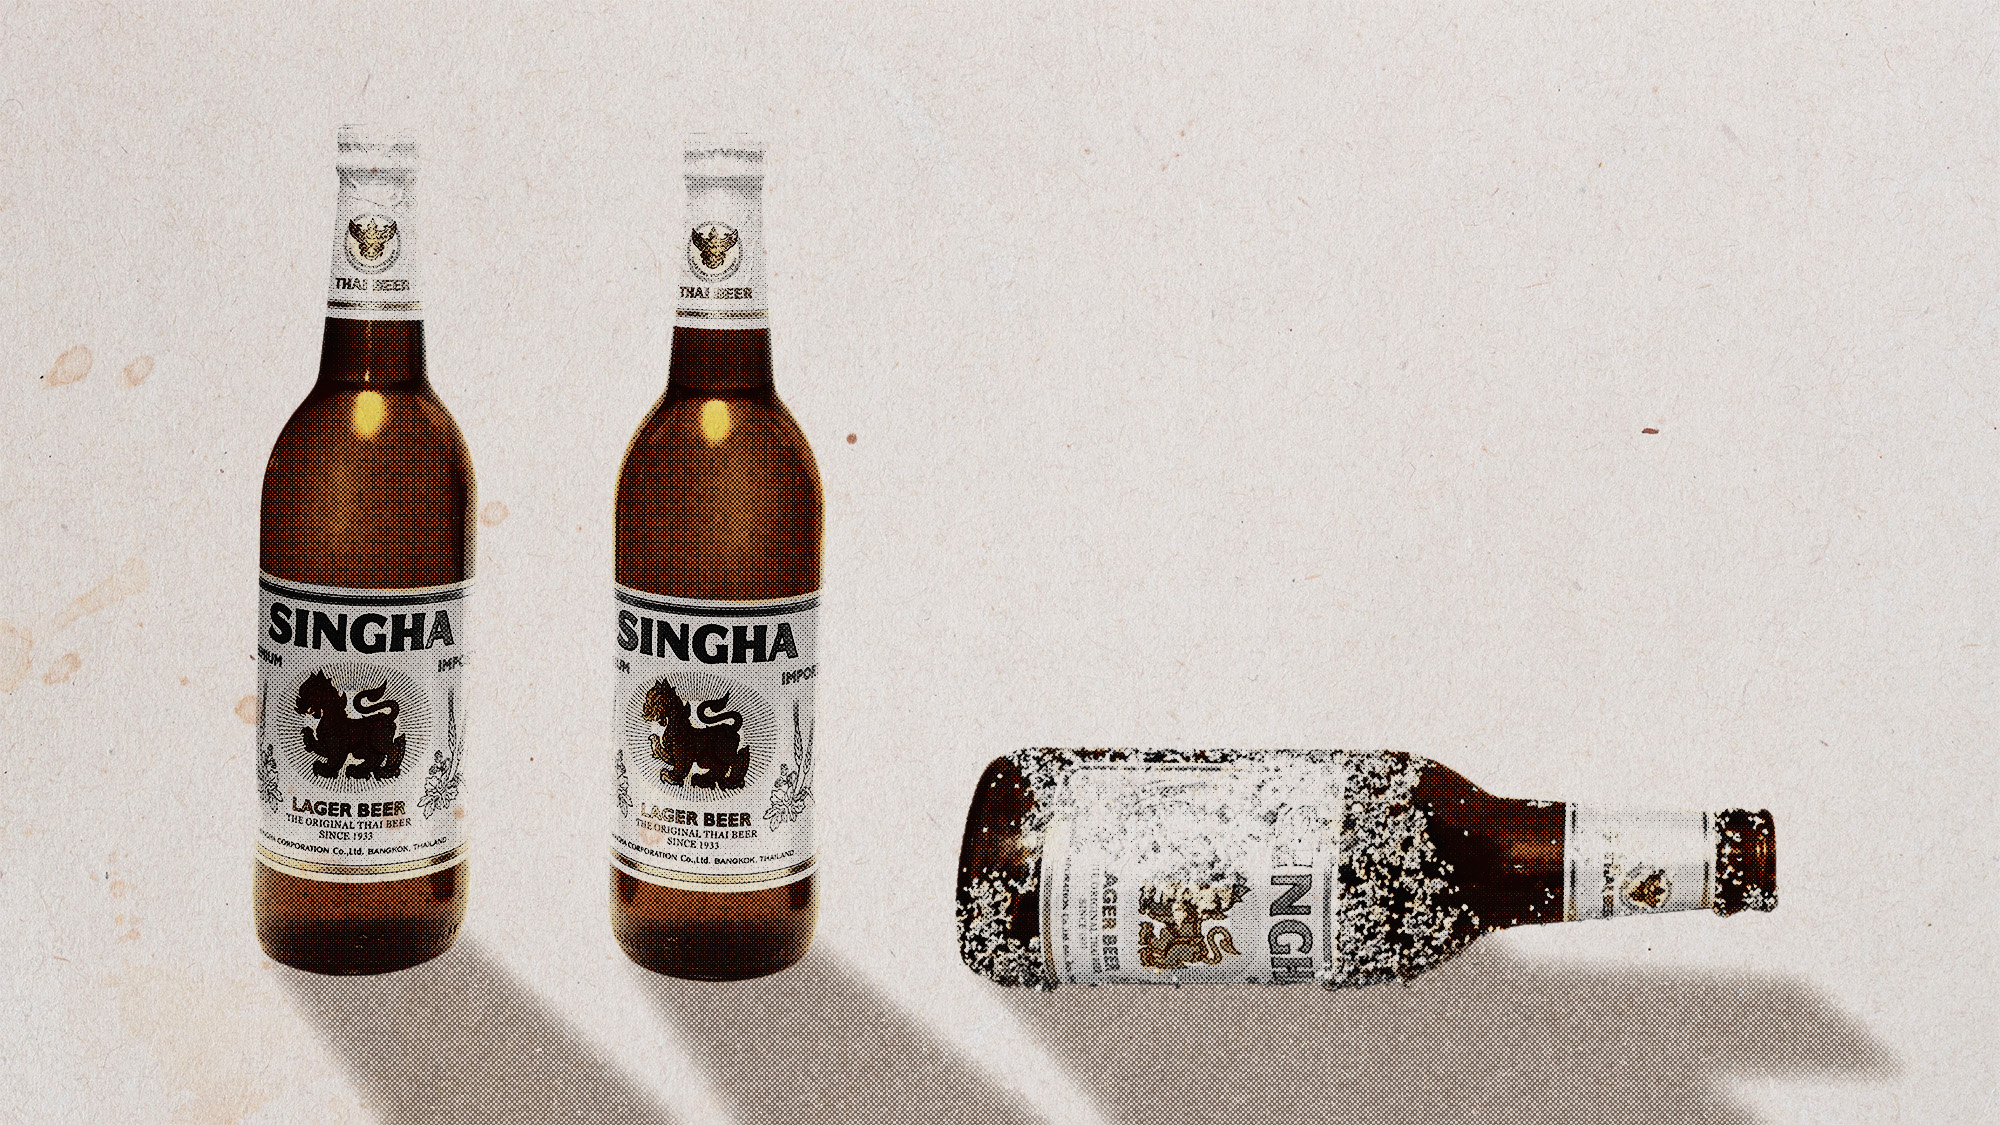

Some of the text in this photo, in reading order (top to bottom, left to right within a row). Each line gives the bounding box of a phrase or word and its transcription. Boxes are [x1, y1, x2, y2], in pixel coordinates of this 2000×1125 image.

[335, 277, 410, 292] THAI BEER
[680, 286, 710, 299] THAI
[268, 602, 455, 655] SINGHA
[616, 609, 799, 665] SINGHA
[292, 796, 406, 818] LAGER BEER
[641, 802, 752, 827] LAGER BEER
[286, 812, 412, 830] THE ORIGINAL THAI BEER
[635, 818, 758, 839] THE ORIGINAL THAI BEER
[277, 837, 329, 854] CORPORATION
[319, 830, 374, 841] SINCE 1933
[667, 837, 720, 850] SINCE 1933
[627, 841, 678, 861] CORPORATION
[1102, 871, 1119, 930] AGER
